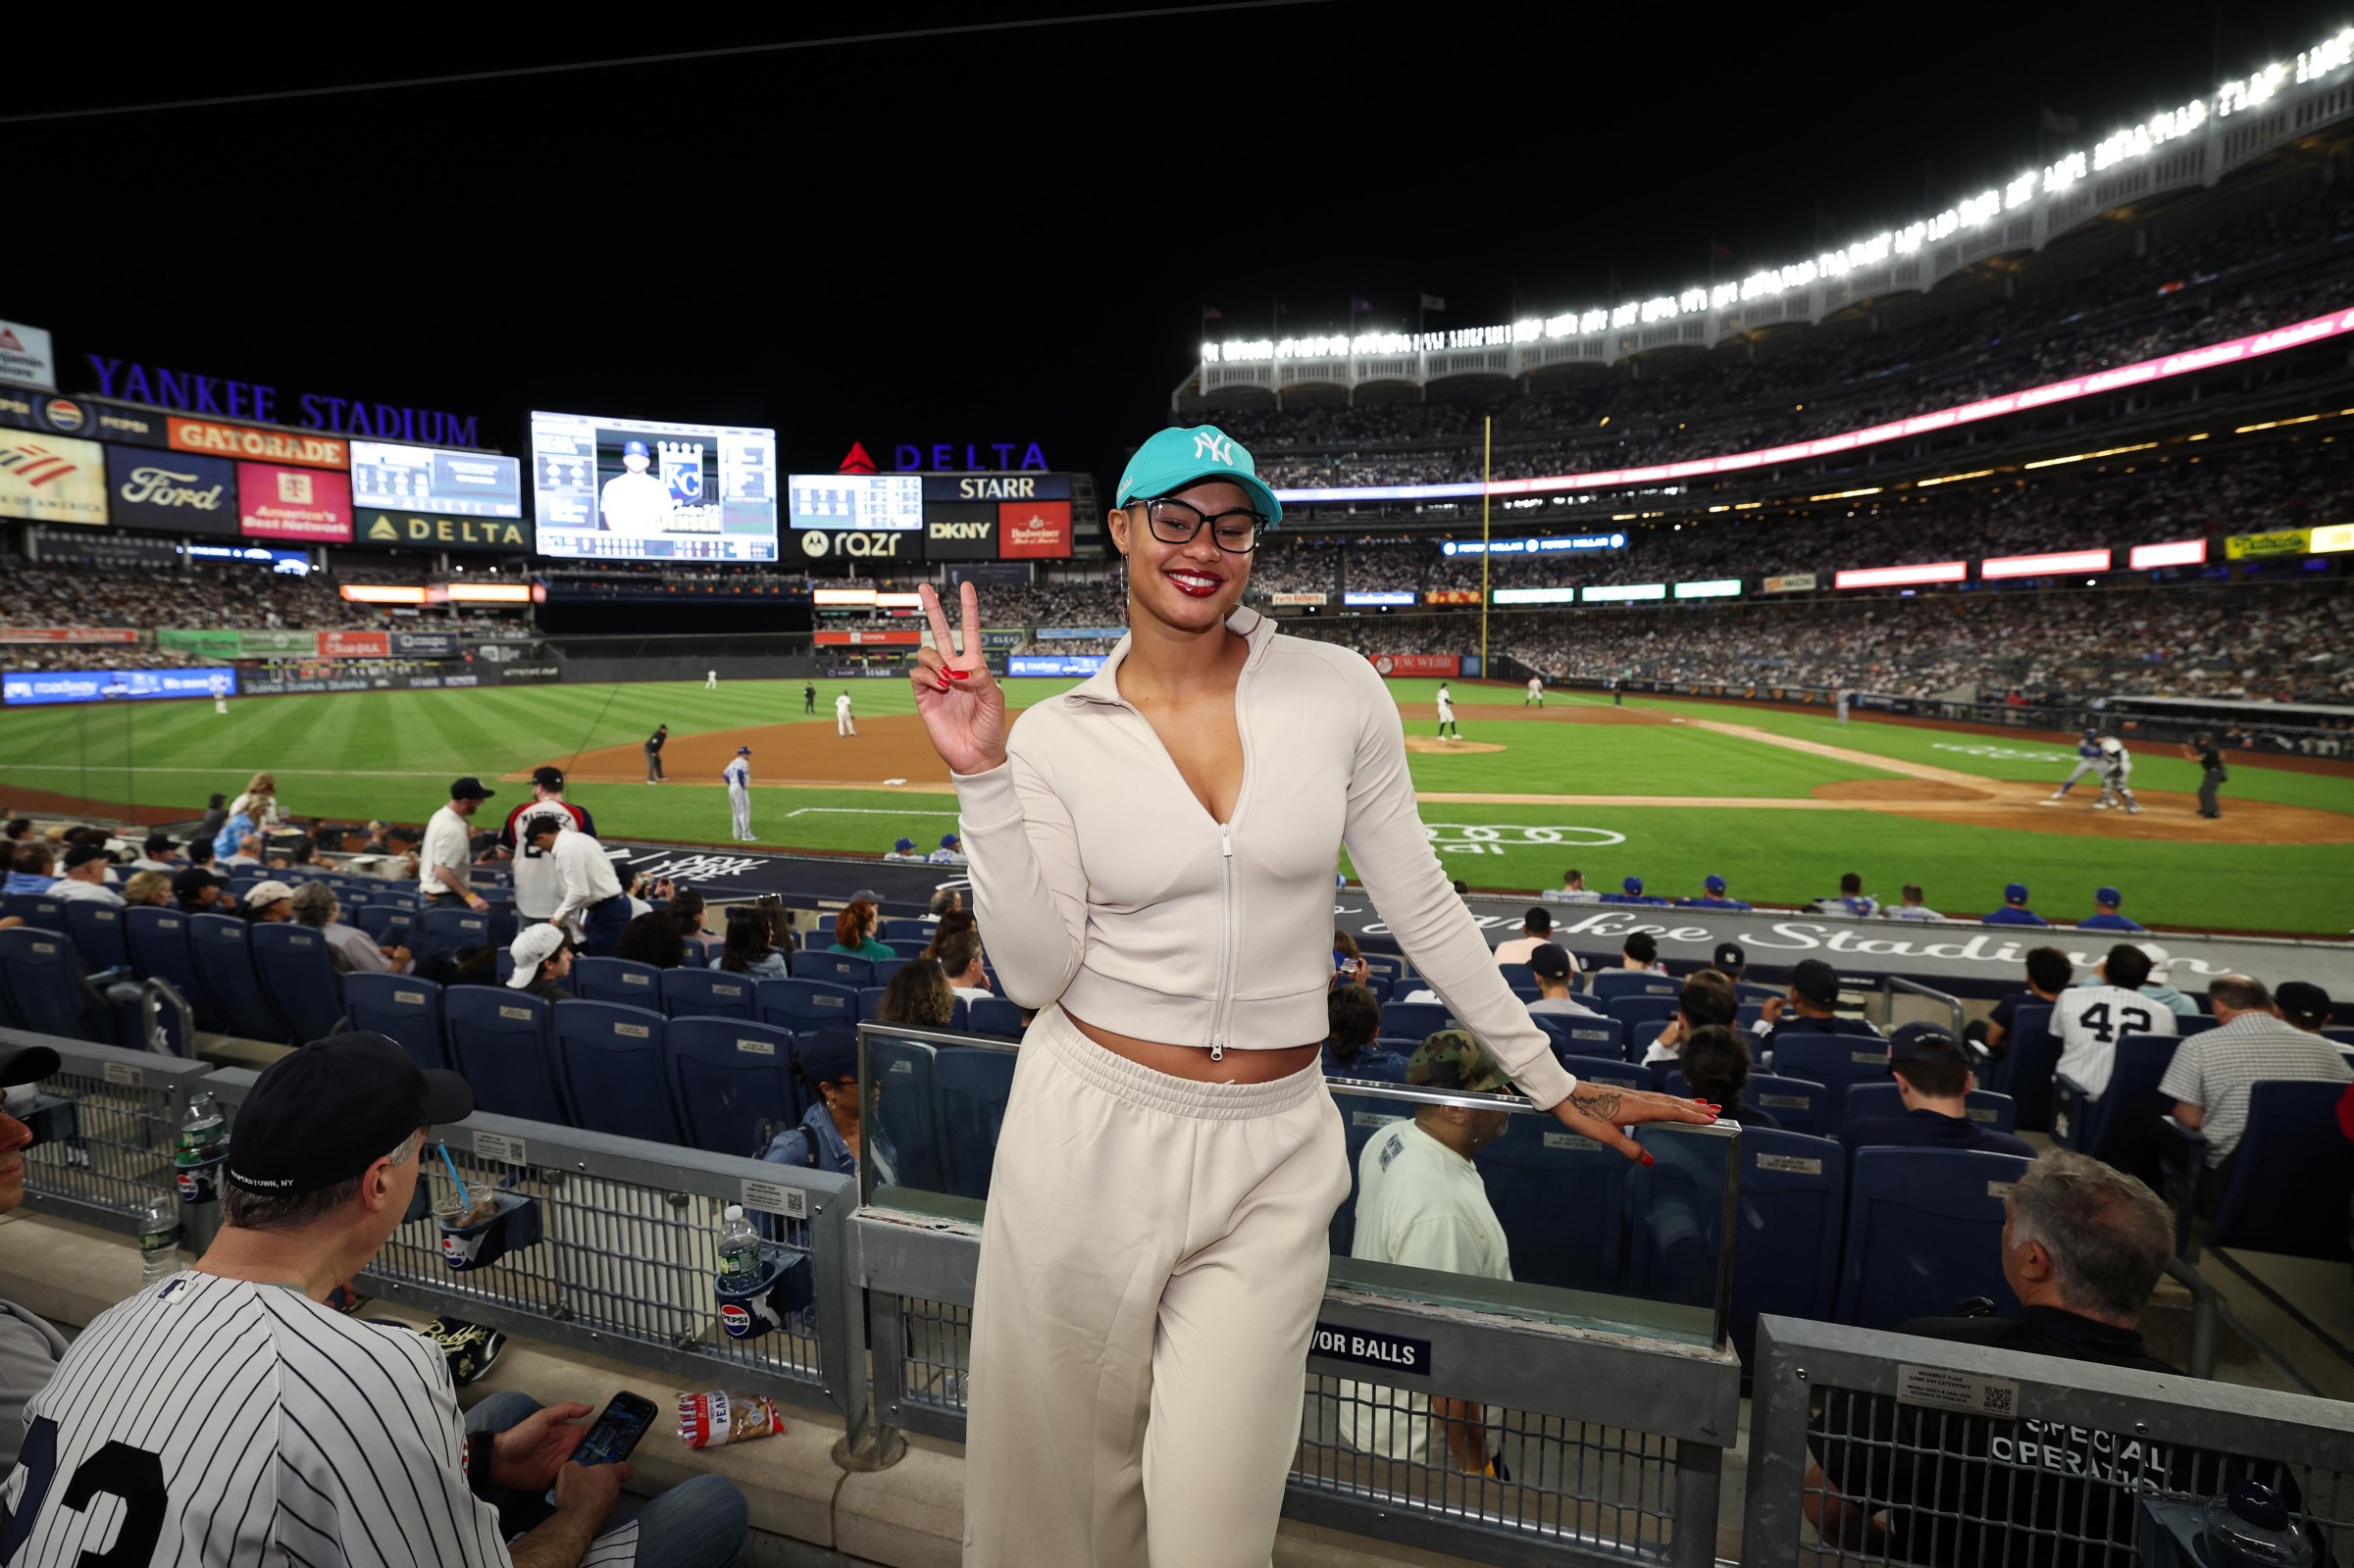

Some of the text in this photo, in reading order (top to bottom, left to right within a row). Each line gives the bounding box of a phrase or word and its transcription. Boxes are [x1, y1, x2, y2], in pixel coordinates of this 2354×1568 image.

[86, 353, 479, 448] YANKEE STADIUM
[178, 424, 342, 464] GATORADE
[895, 442, 1049, 472] DELTA
[121, 466, 224, 510] Ford
[959, 478, 1036, 499] STARR
[408, 518, 525, 545] DELTA
[834, 531, 902, 557] razr
[929, 522, 992, 539] DKNY
[2079, 1002, 2152, 1043] 42
[723, 1314, 748, 1325] PEPSI
[1311, 1331, 1415, 1365] /OR BALLS
[714, 1392, 728, 1425] PEAN
